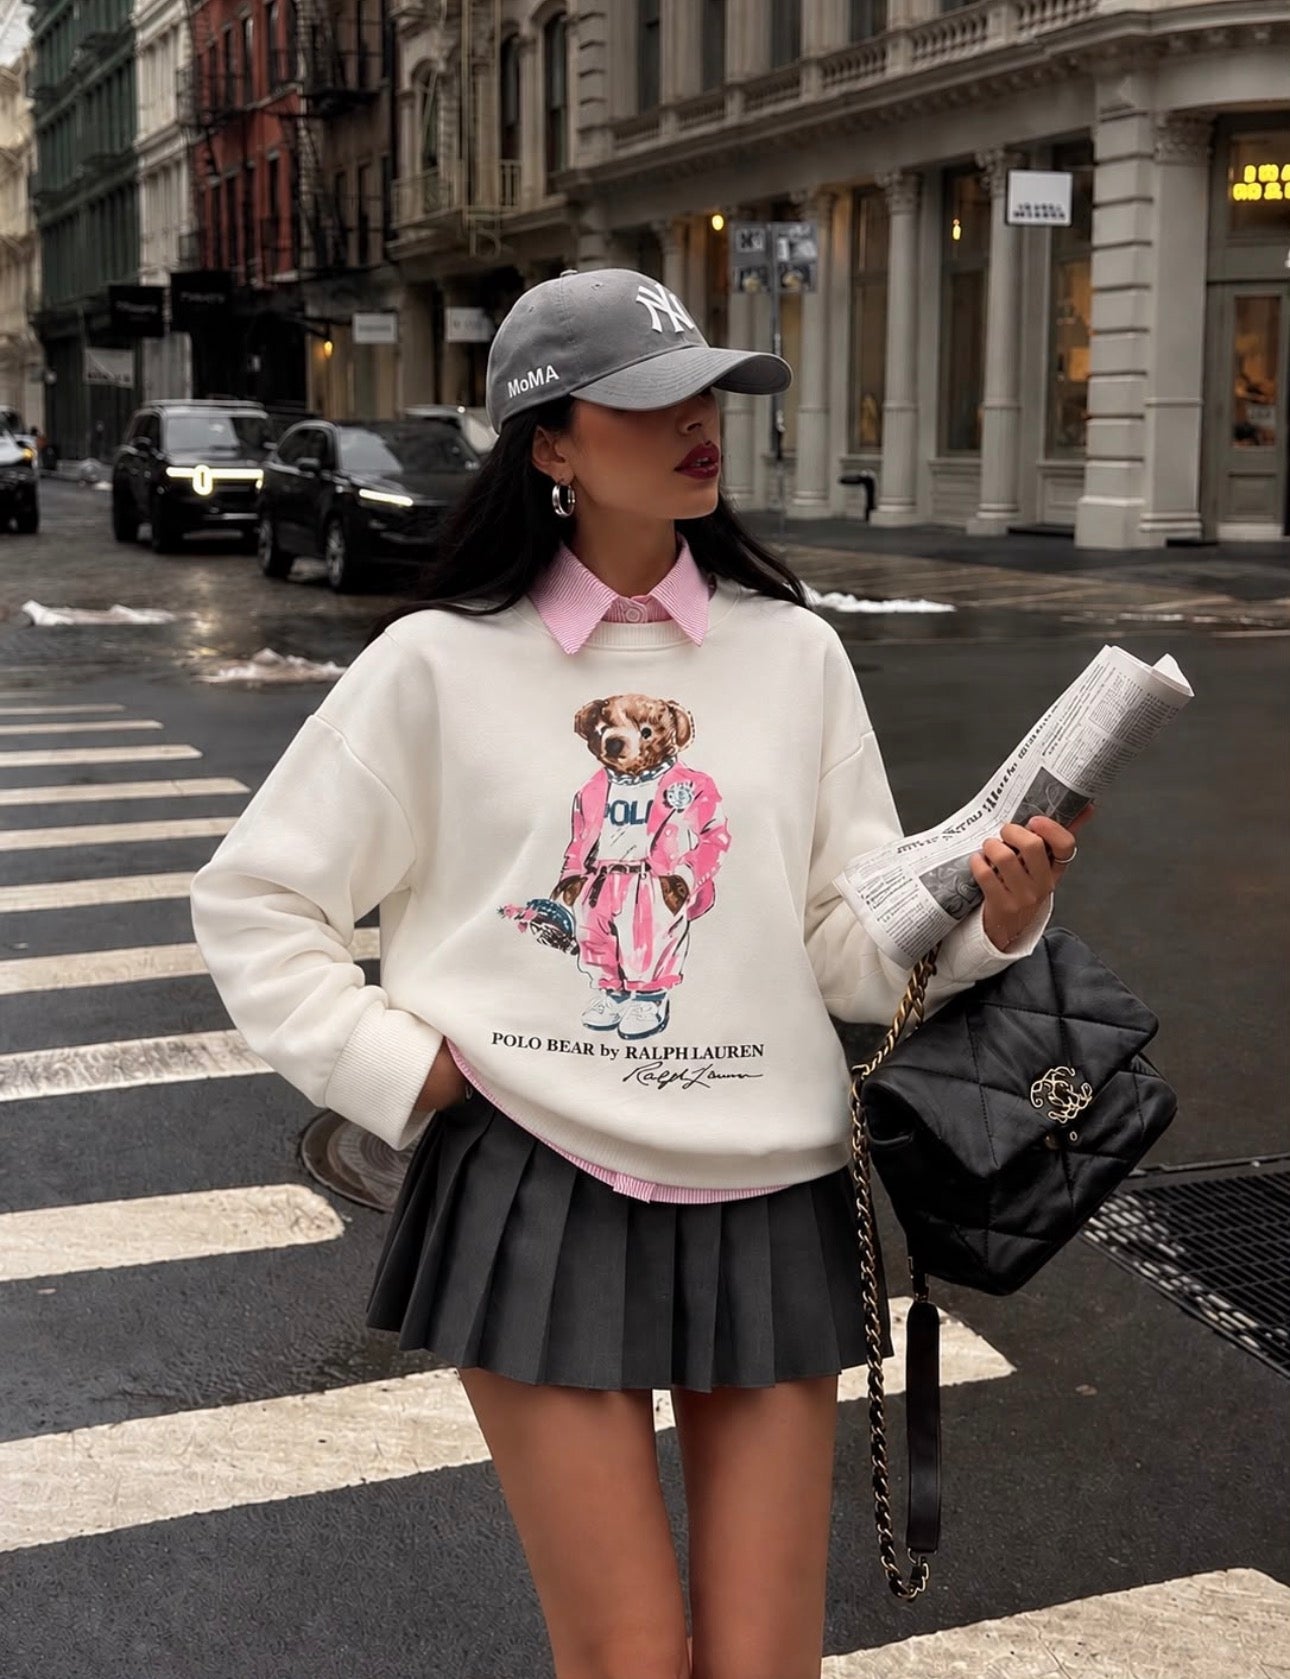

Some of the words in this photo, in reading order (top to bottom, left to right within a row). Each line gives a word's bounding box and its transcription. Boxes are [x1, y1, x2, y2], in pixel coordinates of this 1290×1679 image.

[635, 283, 695, 333] NY
[507, 364, 560, 398] MoMA
[604, 799, 653, 827] OL
[491, 1031, 542, 1050] POLO
[547, 1039, 595, 1056] BEAR
[600, 1043, 620, 1060] by
[624, 1046, 688, 1060] RALPH
[690, 1044, 765, 1060] LAUREN
